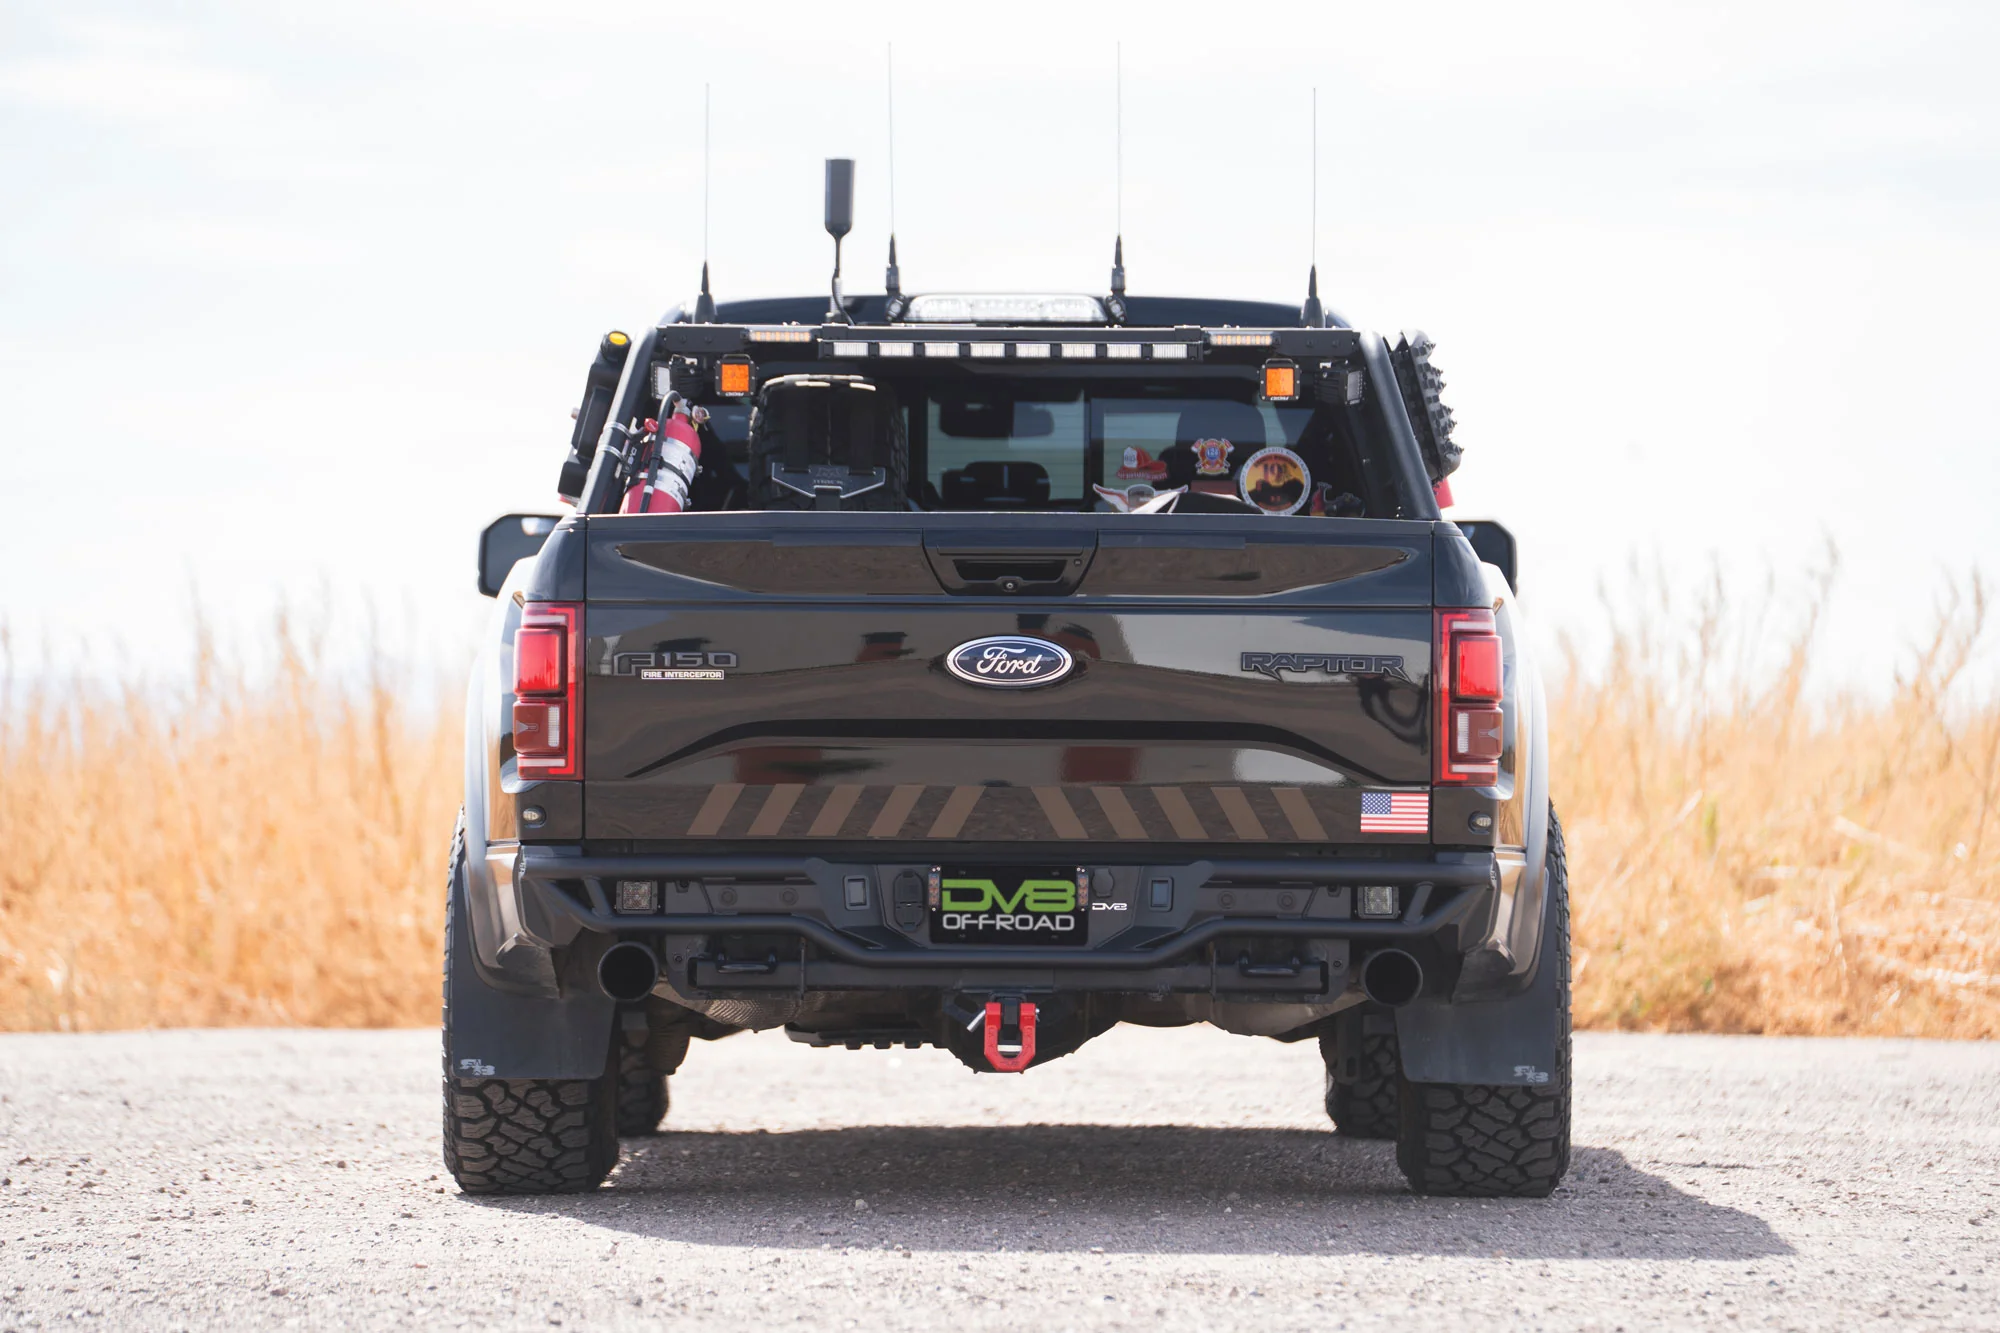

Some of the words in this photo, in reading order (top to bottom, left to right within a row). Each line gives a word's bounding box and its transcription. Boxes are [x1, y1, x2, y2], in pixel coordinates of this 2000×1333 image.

[976, 646, 1043, 674] Ford
[1240, 652, 1412, 683] RAPTOR
[942, 879, 1076, 914] DV8
